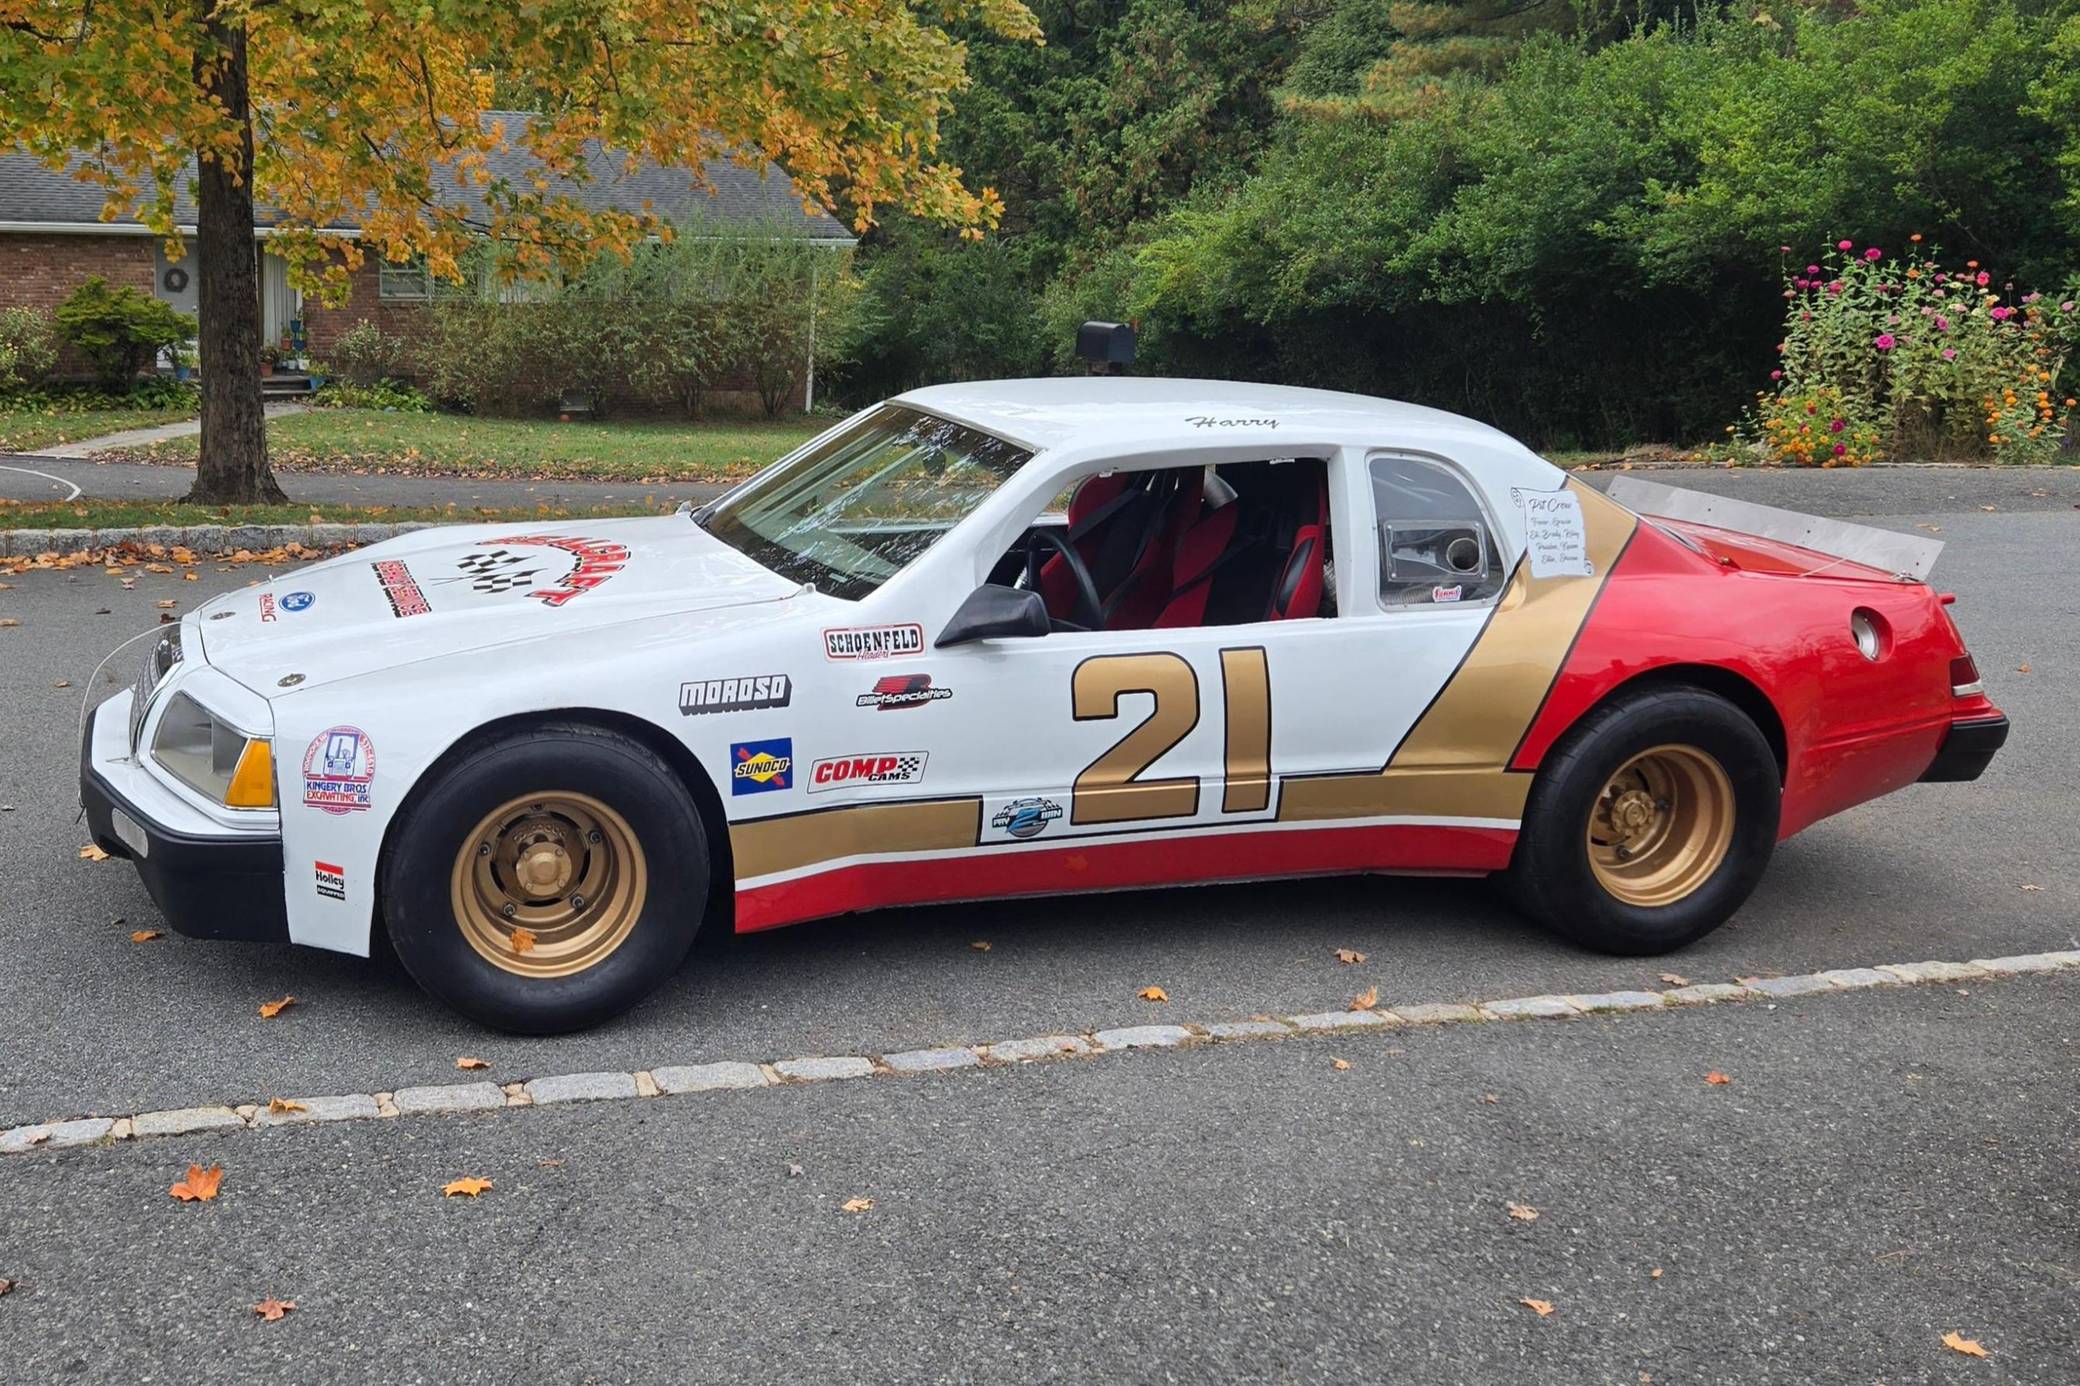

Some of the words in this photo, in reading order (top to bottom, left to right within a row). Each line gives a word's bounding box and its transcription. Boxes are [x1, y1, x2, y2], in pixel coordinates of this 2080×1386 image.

[1184, 416, 1280, 429] Harry
[1529, 498, 1547, 512] Pit
[1547, 498, 1572, 512] Crew
[828, 629, 919, 653] SCHOENFELD
[679, 674, 792, 715] MOROSO
[1070, 645, 1272, 826] 21
[737, 759, 788, 777] SUNOCO
[815, 756, 898, 784] COMP
[868, 772, 911, 782] CAMS
[306, 781, 342, 792] KINGERY
[344, 783, 367, 794] BROS
[315, 870, 344, 890] Holley
